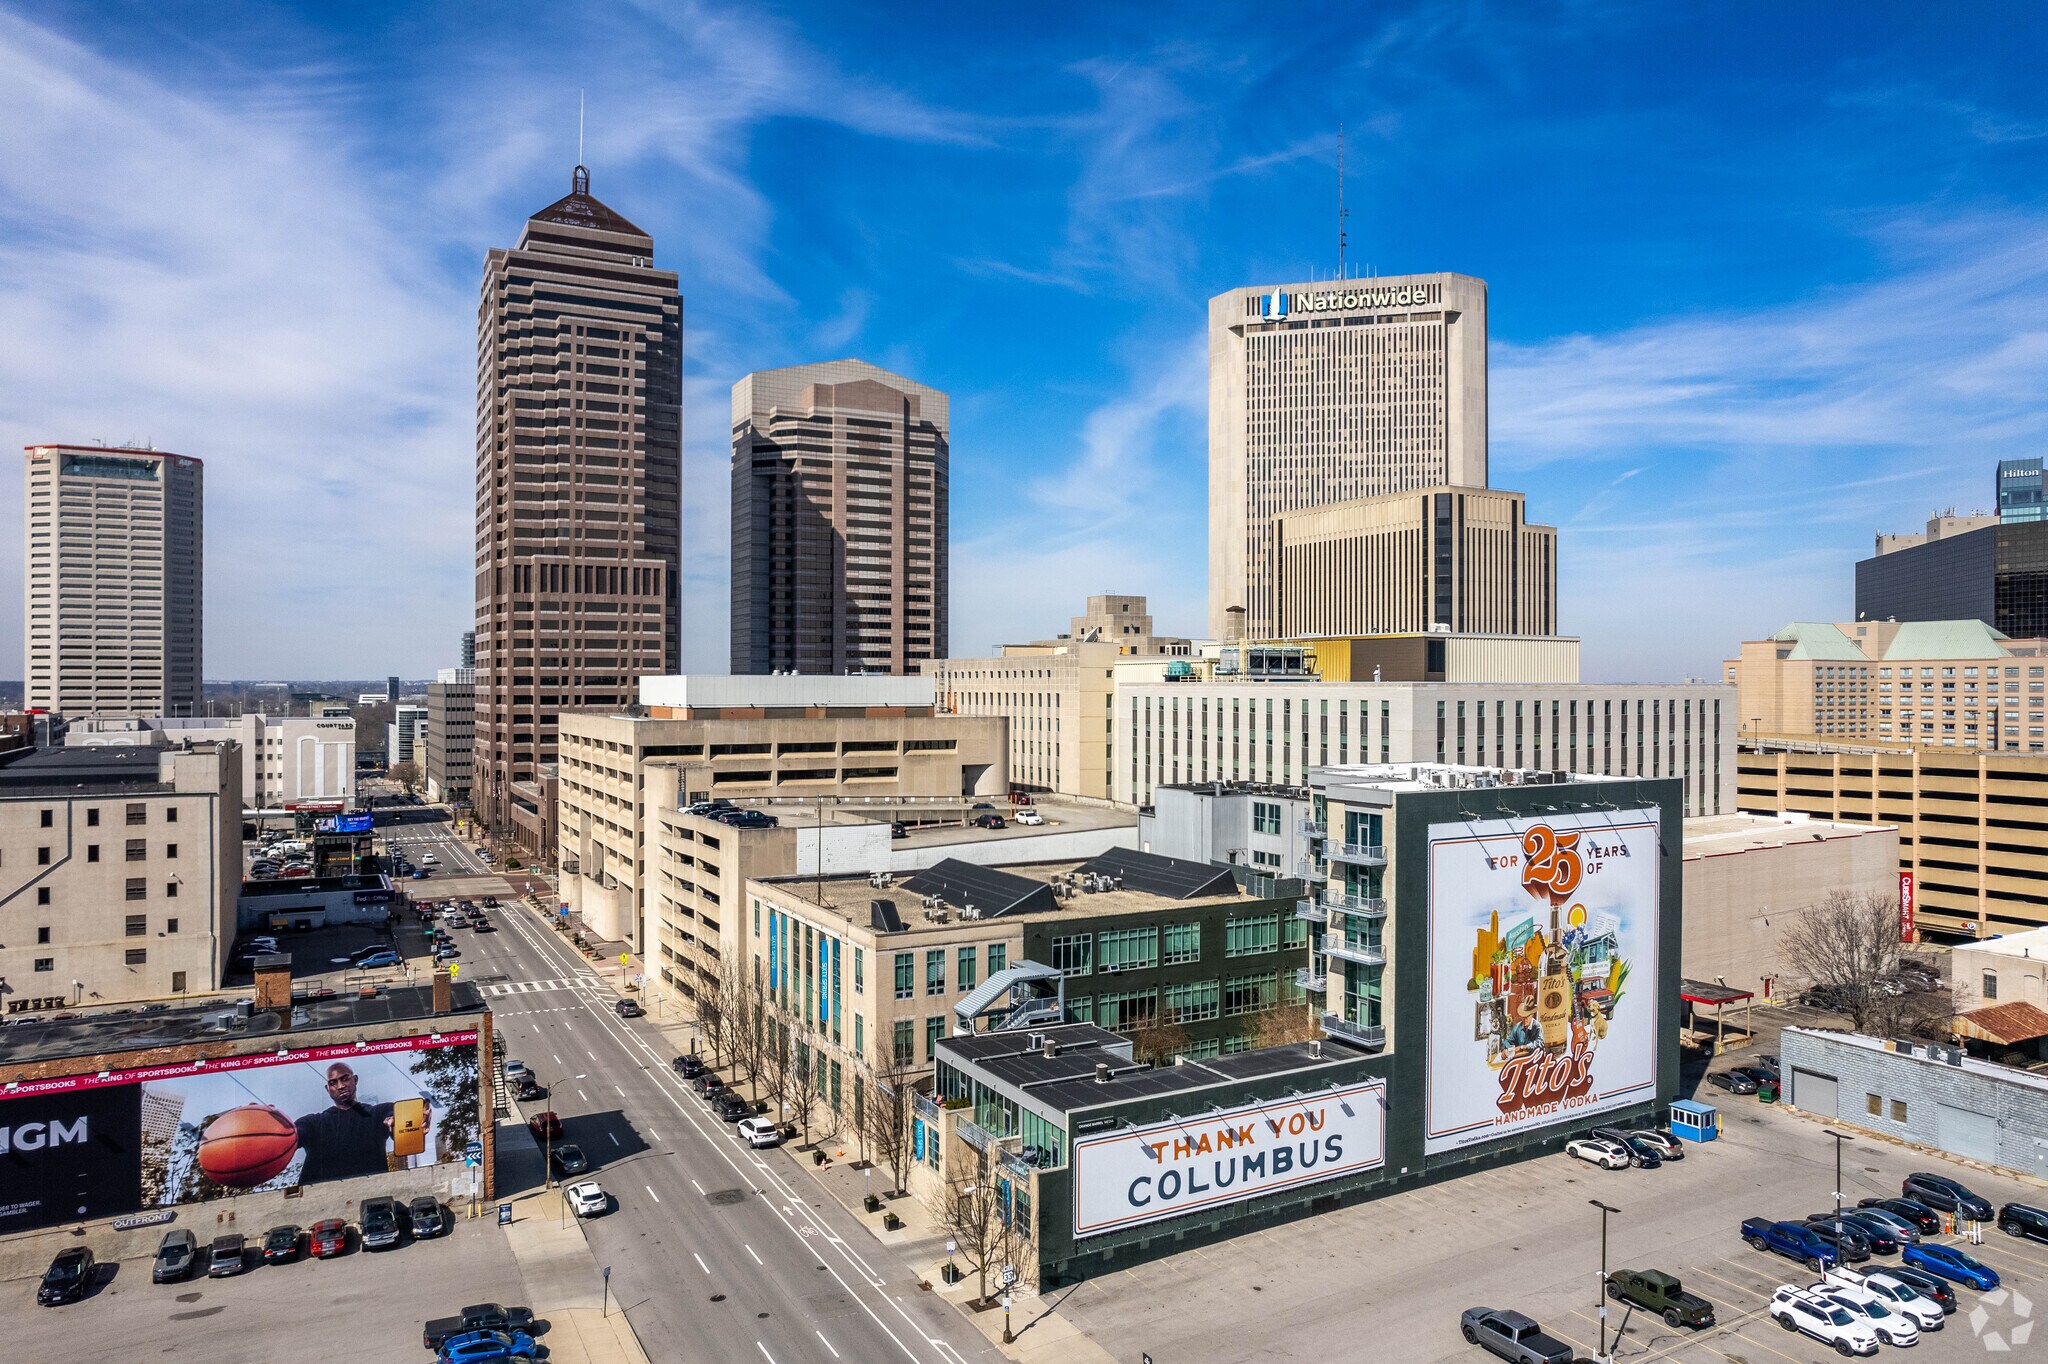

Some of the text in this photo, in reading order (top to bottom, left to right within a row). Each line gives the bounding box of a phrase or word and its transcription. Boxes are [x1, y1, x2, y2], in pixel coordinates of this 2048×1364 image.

[1297, 286, 1426, 311] Nationwide
[2003, 469, 2039, 478] Hilton
[1491, 824, 1627, 894] FOR 25 YEARS
[1587, 862, 1604, 875] OF
[1543, 976, 1565, 990] Tito's
[84, 1077, 100, 1085] THE
[125, 1072, 137, 1080] OF
[137, 1065, 198, 1079] SPORTSBOOKS
[205, 1062, 221, 1070] THE
[221, 1060, 241, 1069] KING
[330, 1047, 349, 1056] KING
[418, 1038, 432, 1046] THE
[1498, 1043, 1594, 1104] Tito's
[1495, 1103, 1558, 1126] HANDMADE
[1562, 1094, 1598, 1110] VODKA
[0, 1116, 88, 1155] GM
[1151, 1108, 1325, 1164] THANK YOU
[1128, 1134, 1343, 1207] COLUMBUS
[114, 1211, 169, 1228] OUTFRONT
[1004, 1273, 1013, 1281] 33
